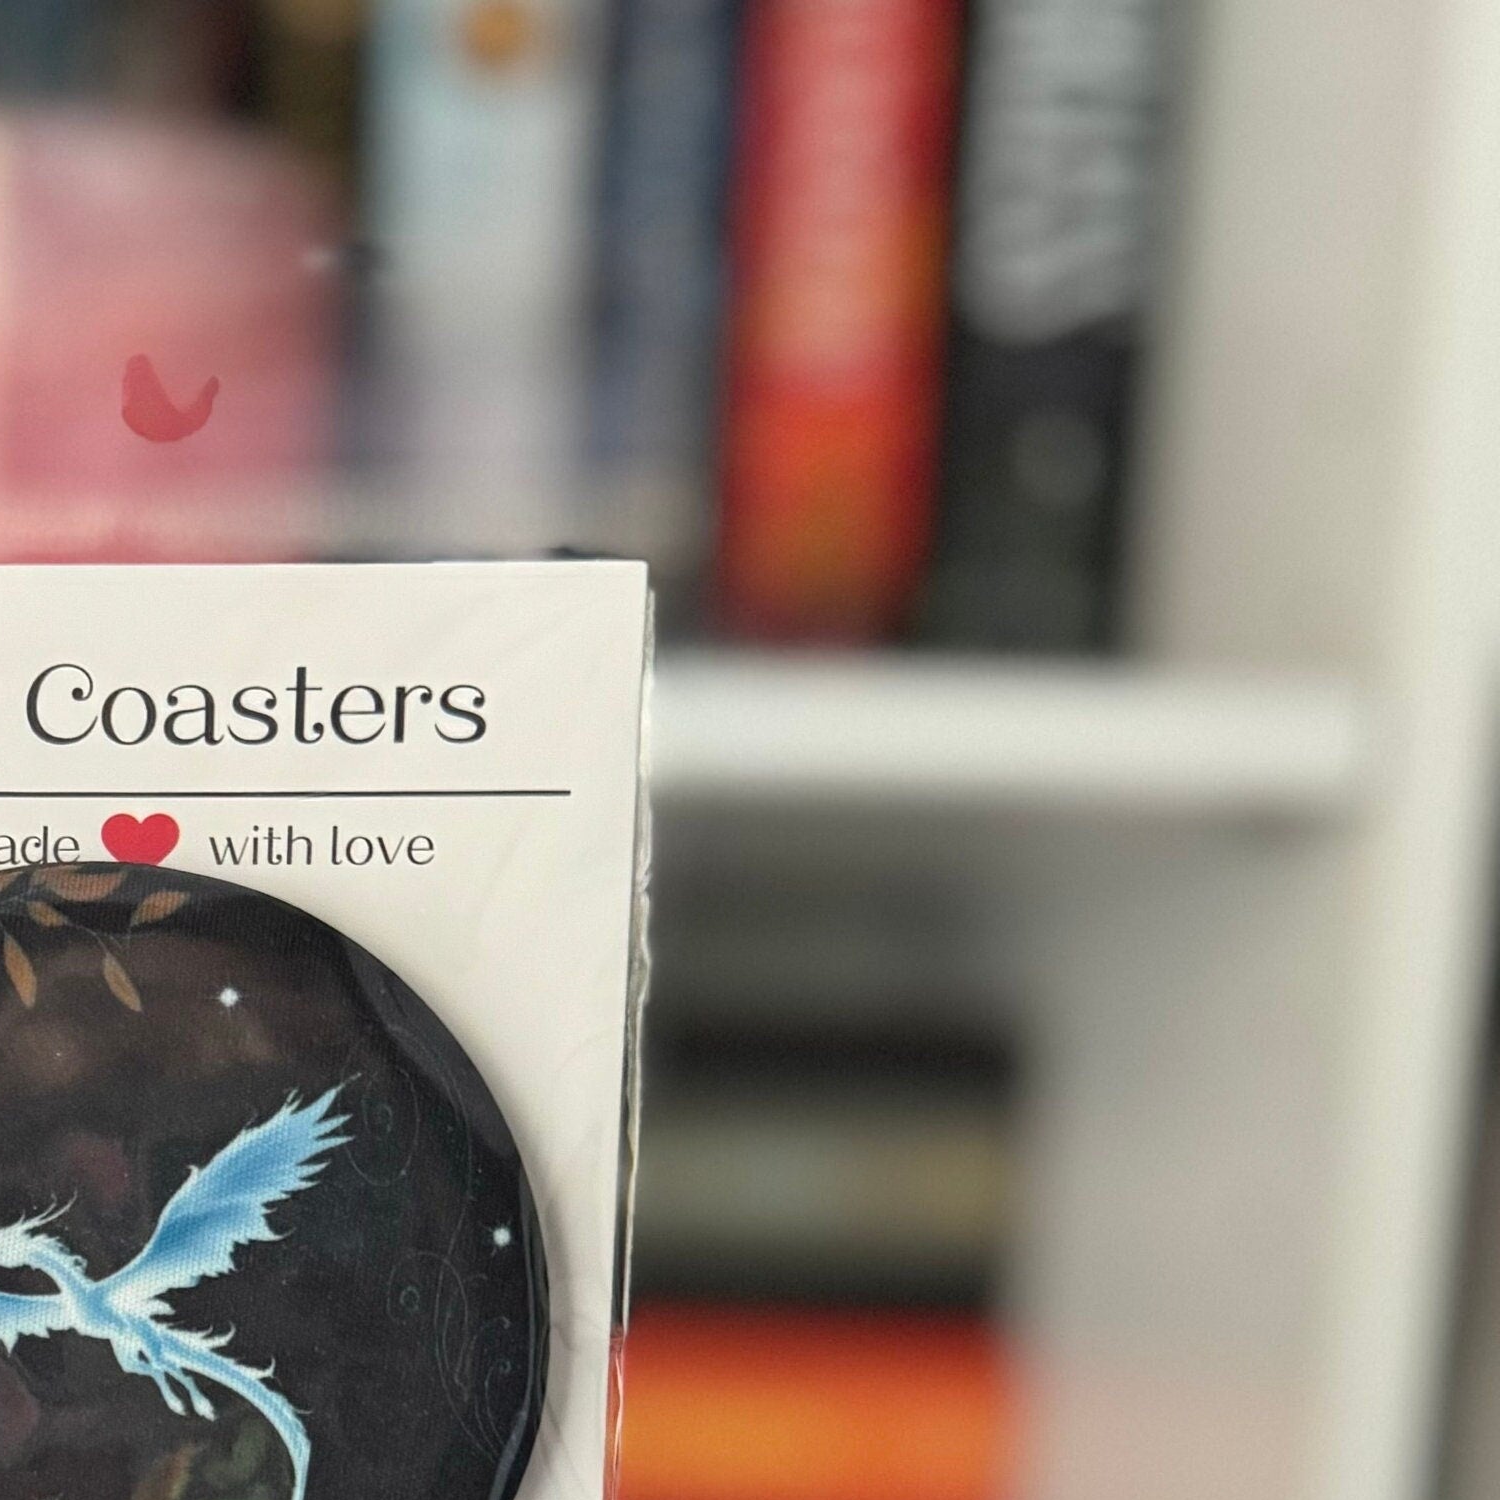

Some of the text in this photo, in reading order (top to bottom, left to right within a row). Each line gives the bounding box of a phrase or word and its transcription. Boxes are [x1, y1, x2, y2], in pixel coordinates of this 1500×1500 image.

[25, 662, 487, 746] Coasters
[209, 825, 313, 866] with
[331, 825, 435, 866] love
